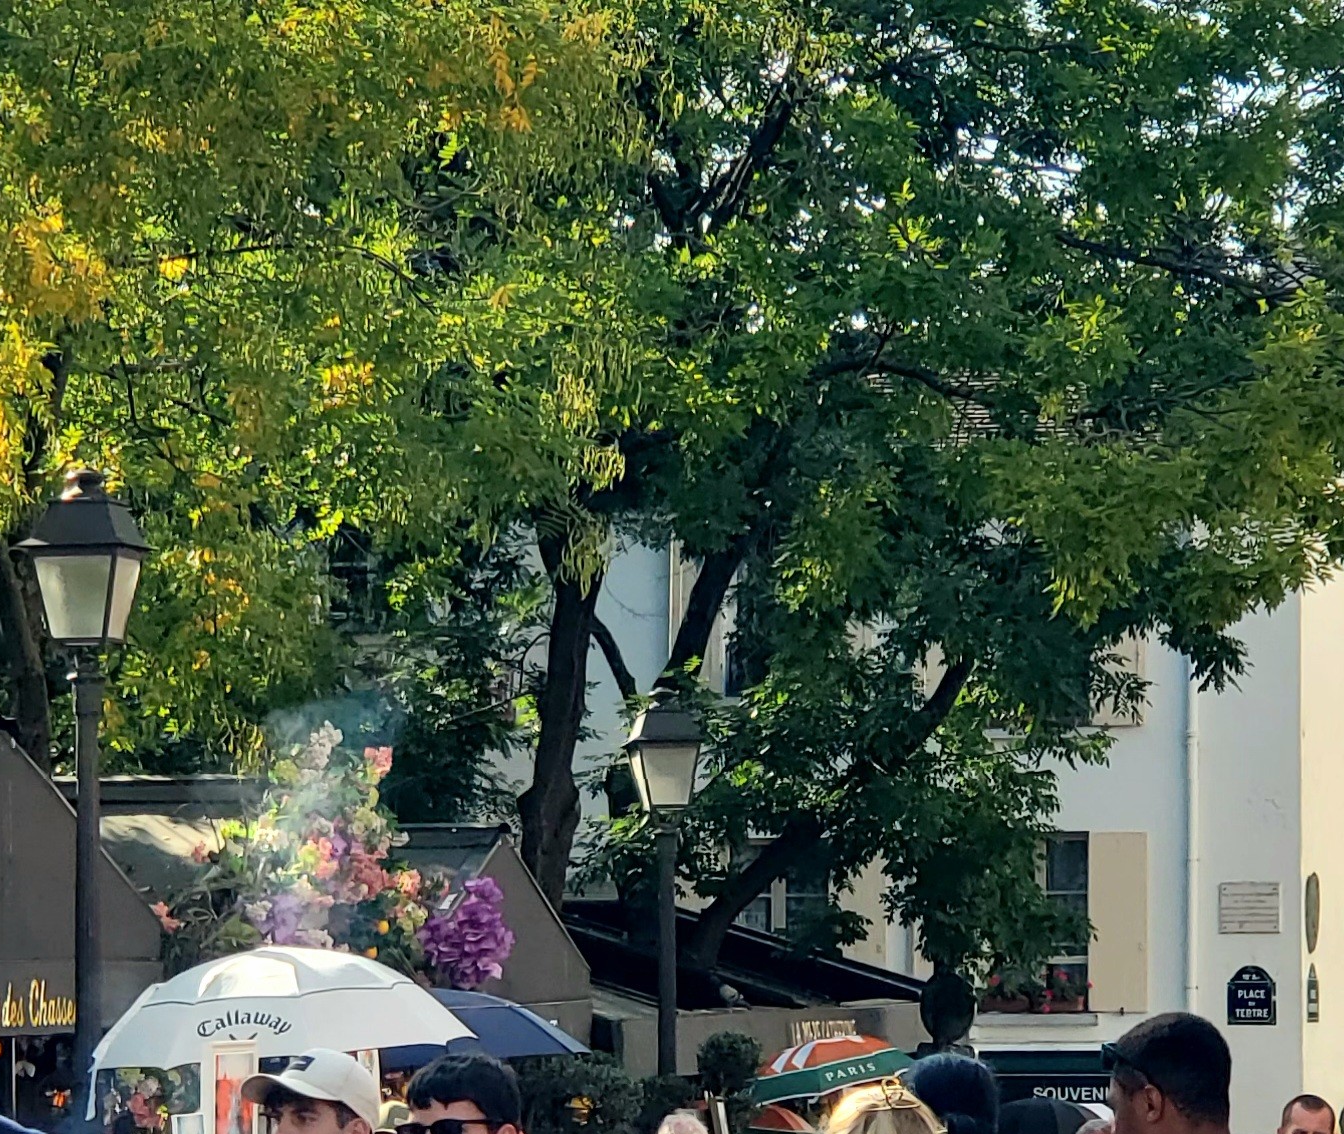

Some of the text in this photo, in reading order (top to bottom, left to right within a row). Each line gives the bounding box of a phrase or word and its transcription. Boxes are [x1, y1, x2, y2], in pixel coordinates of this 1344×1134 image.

[1, 981, 25, 1028] des
[1237, 989, 1266, 999] PLACE
[197, 1009, 292, 1037] Callaway
[824, 1062, 876, 1082] PARIS
